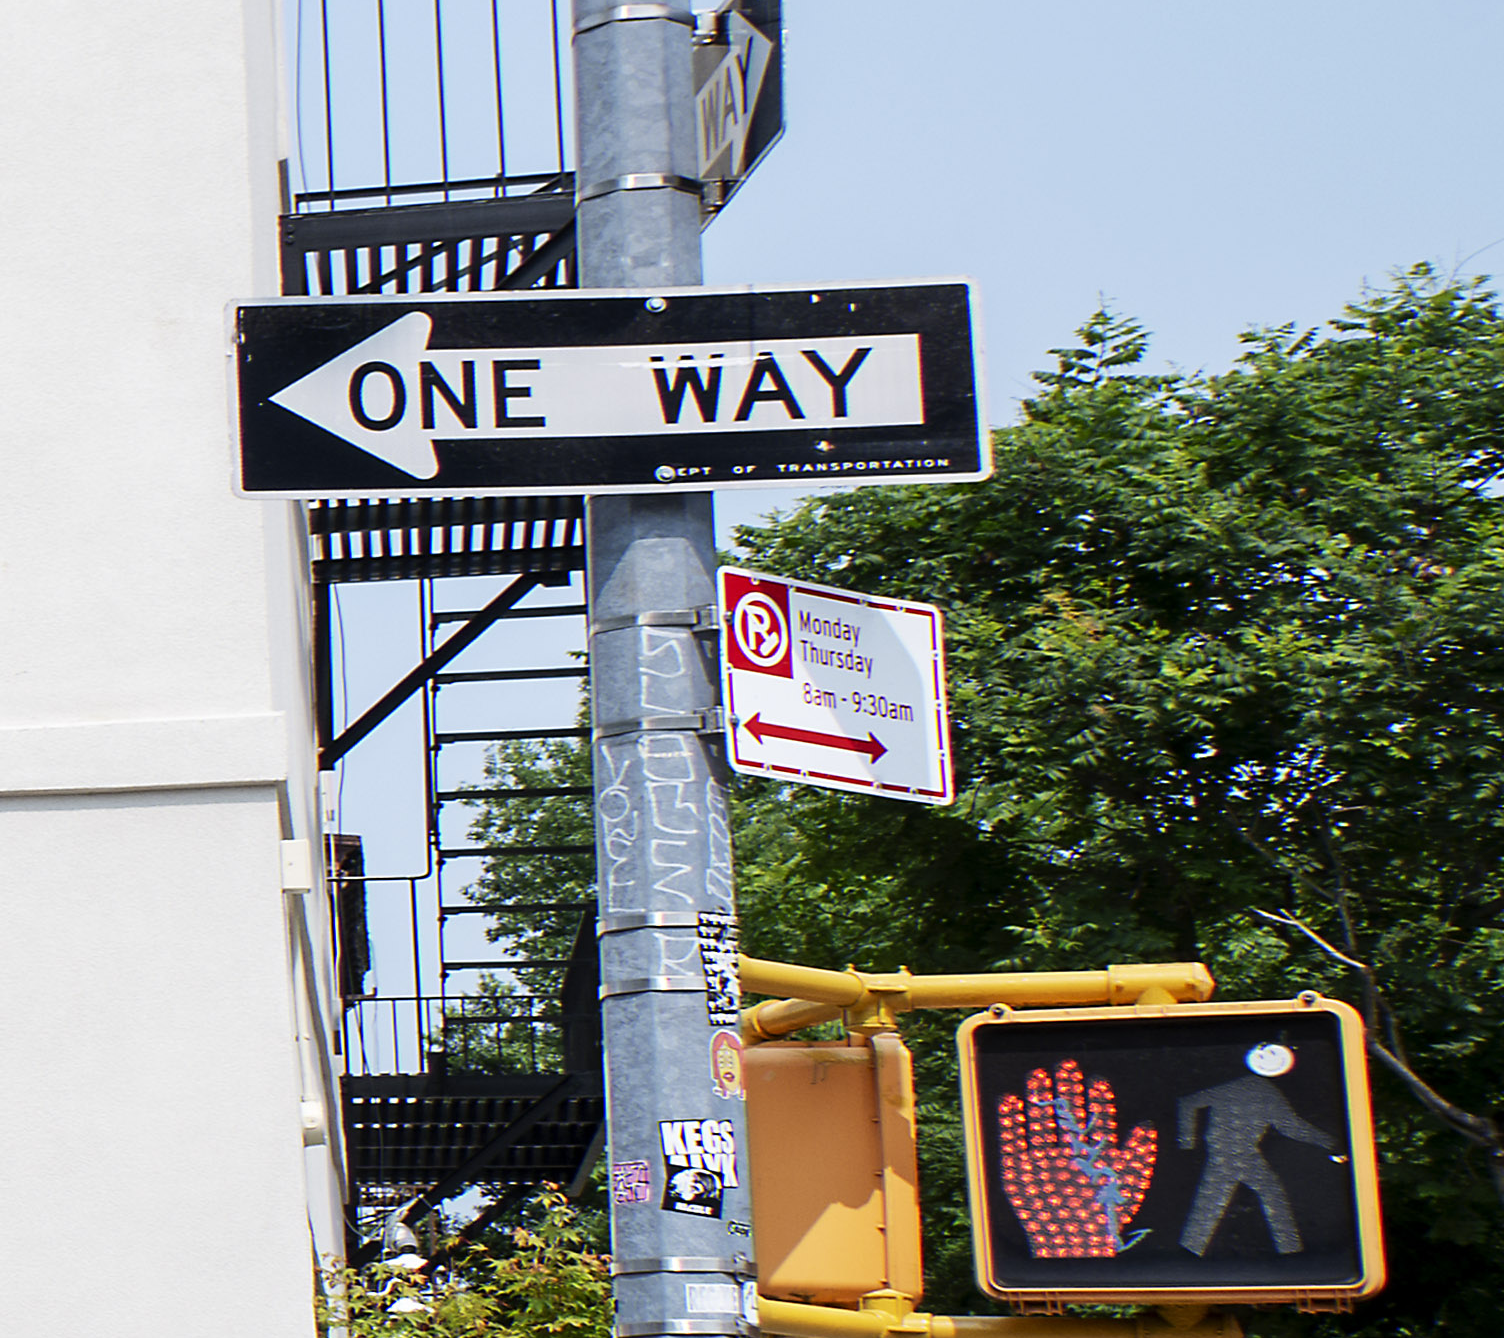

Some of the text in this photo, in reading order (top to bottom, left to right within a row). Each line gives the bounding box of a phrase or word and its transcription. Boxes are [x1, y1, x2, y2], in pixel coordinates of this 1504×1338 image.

[700, 35, 755, 161] WAY
[348, 347, 873, 431] ONE WAY
[654, 458, 950, 482] EPT OF TRANSPORTATION
[797, 610, 861, 648] Monday
[799, 639, 873, 679] Thursday
[802, 682, 838, 709] 8am
[851, 691, 914, 723] 9:30am
[660, 1118, 736, 1156] KEGS
